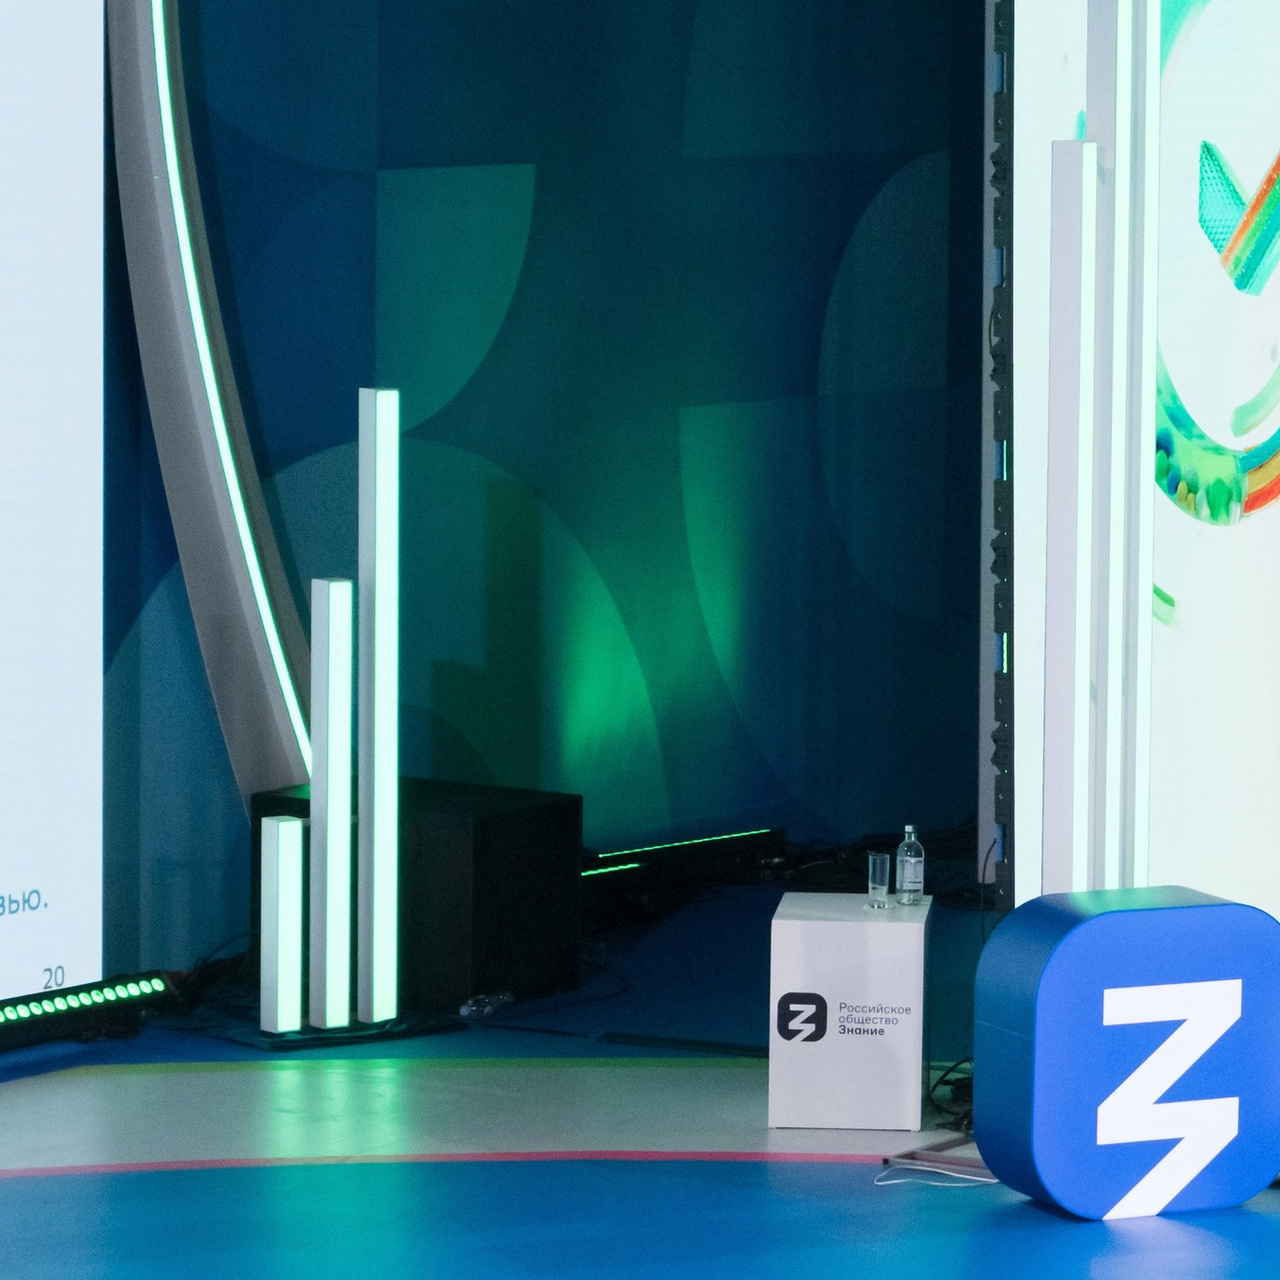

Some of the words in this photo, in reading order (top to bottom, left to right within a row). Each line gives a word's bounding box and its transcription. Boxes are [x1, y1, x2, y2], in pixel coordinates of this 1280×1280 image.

[43, 965, 64, 989] 20
[839, 1003, 911, 1014] Российское
[839, 1015, 898, 1025] общество
[839, 1025, 885, 1035] Знание
